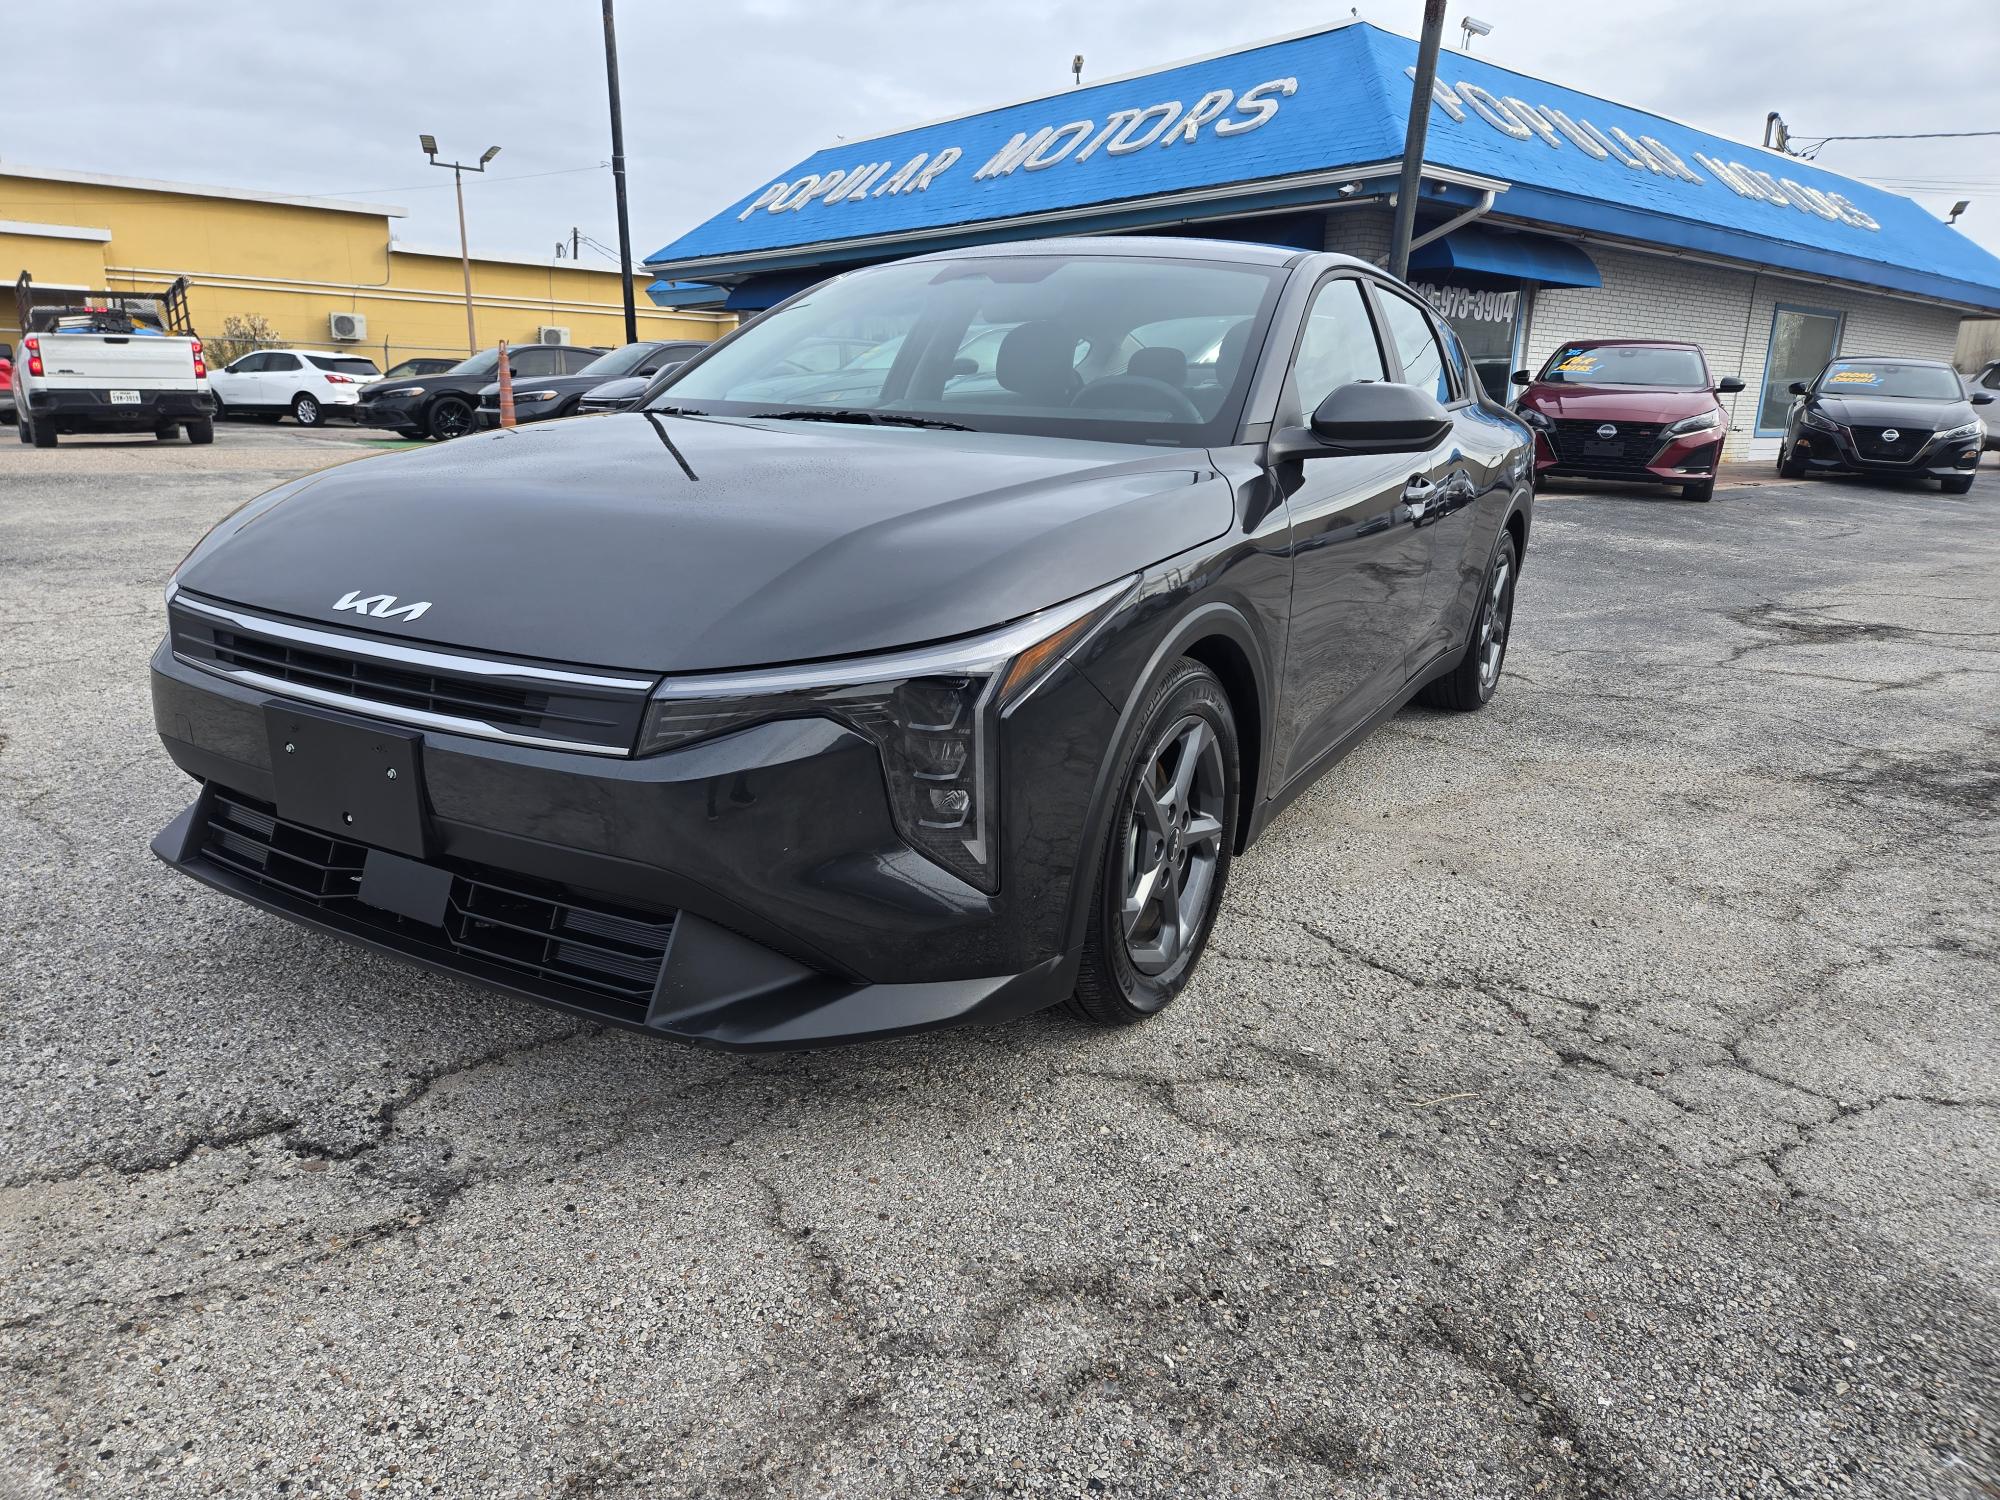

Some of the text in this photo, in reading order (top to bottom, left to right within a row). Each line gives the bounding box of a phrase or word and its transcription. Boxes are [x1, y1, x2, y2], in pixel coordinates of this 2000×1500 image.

[737, 77, 1298, 222] POPULAR MOTORS
[1403, 66, 1706, 186] POPULAR
[332, 590, 433, 622] KIA
